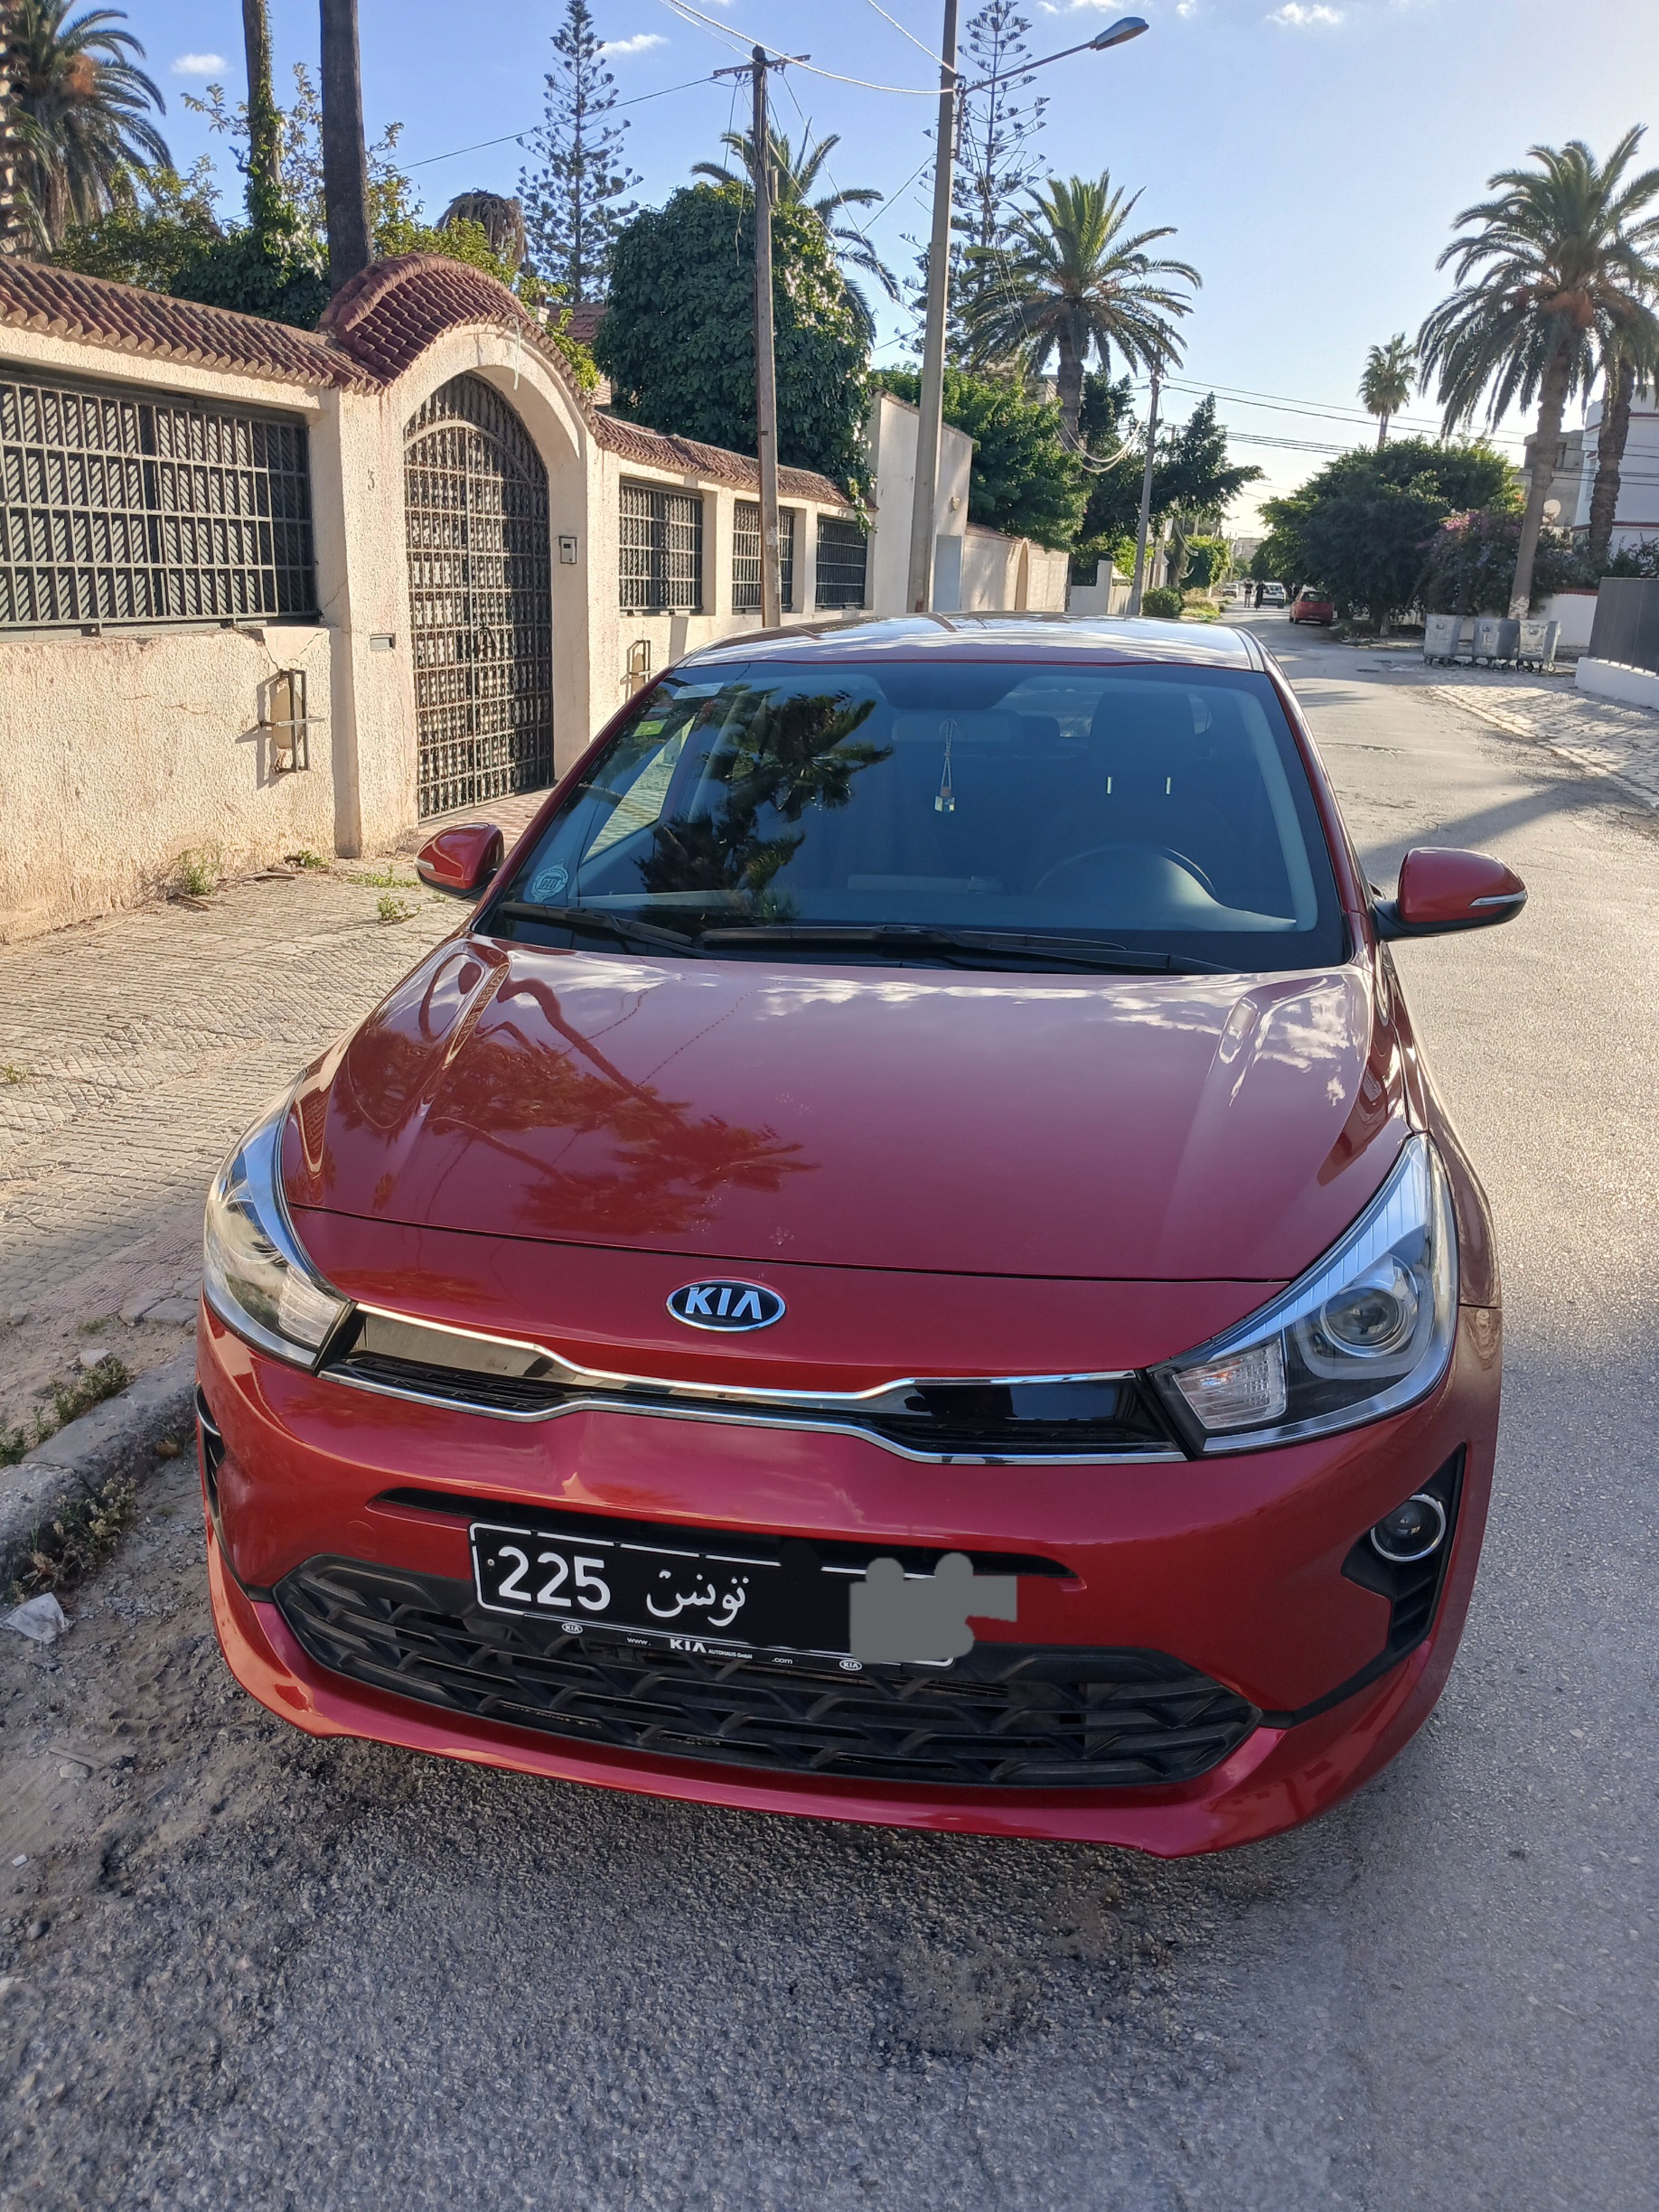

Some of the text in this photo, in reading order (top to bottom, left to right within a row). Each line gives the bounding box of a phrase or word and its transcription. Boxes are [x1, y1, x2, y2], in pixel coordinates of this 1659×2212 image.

[684, 1286, 763, 1320] KIA
[498, 1546, 611, 1611] 225
[646, 1569, 750, 1627] تونس
[670, 1638, 707, 1654] KIA
[772, 1657, 793, 1665] .com
